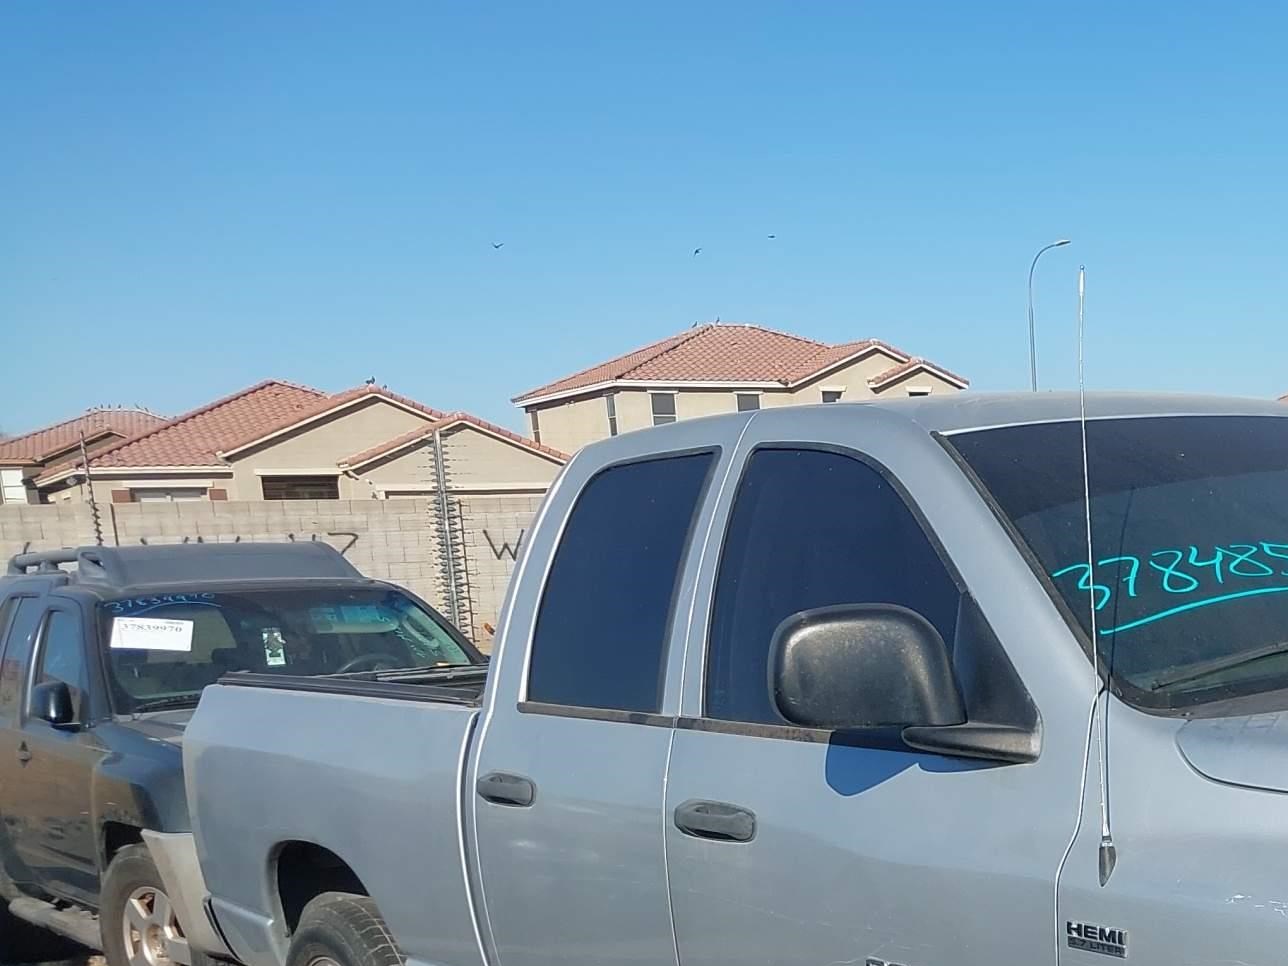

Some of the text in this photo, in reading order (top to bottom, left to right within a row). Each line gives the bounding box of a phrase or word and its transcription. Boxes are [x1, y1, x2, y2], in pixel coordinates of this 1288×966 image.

[121, 623, 183, 633] 37839970
[1066, 920, 1128, 946] HEMI
[1089, 942, 1126, 957] LITER
